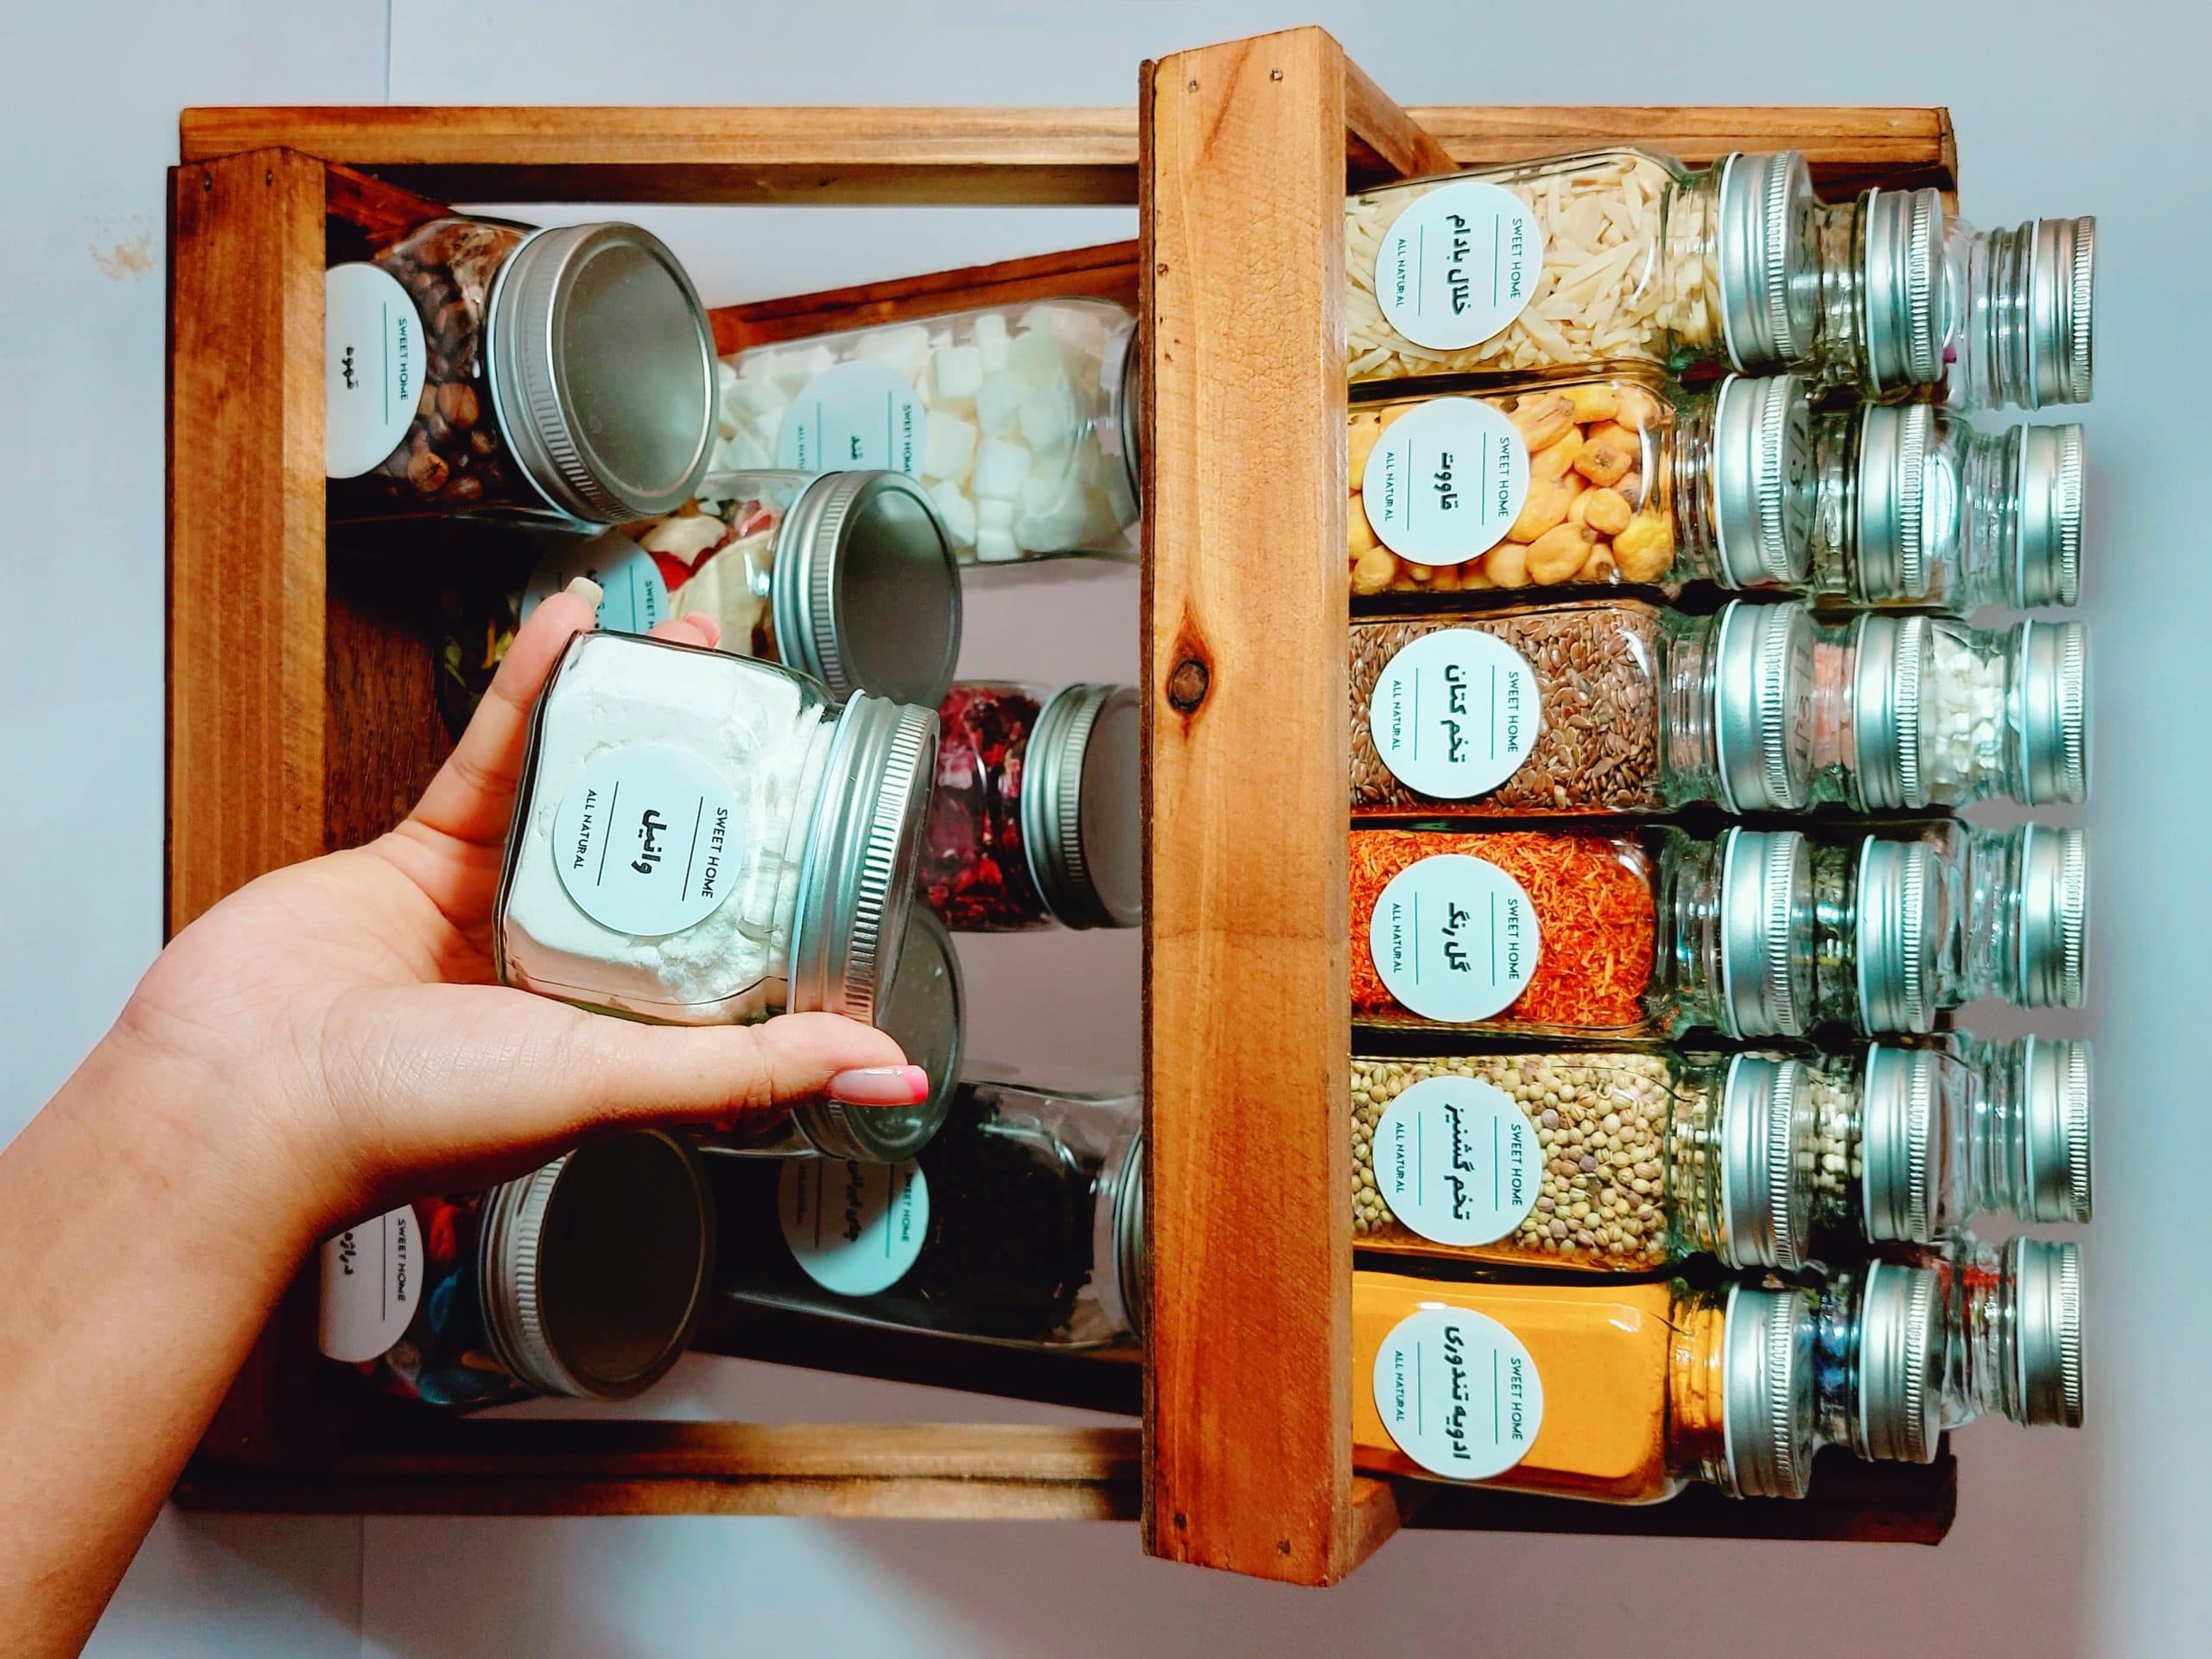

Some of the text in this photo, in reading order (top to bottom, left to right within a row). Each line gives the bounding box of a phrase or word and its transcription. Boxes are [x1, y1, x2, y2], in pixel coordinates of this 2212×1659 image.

[1395, 238, 1407, 308] ALL NATURAL
[1446, 214, 1471, 315] خلال بادام
[1509, 218, 1523, 300] SWEET HOME
[342, 346, 359, 390] قهوه
[398, 318, 409, 401] SWEET HOME
[903, 404, 912, 474] SWEET HOME
[1384, 451, 1395, 522] ALL NATURAL
[1434, 452, 1459, 512] قاووت
[1497, 435, 1510, 518] SWEET HOME
[645, 581, 655, 617] SWEET
[1391, 679, 1402, 751] ALL NATURAL
[1441, 664, 1468, 763] تخم کتان
[1507, 671, 1519, 753] SWEET HOME
[573, 789, 598, 869] ALL NATURAL
[631, 810, 667, 875] وانیل
[702, 807, 728, 899] SWEET HOME
[1392, 903, 1402, 975] ALL NATURAL
[1446, 941, 1471, 973] گل
[1507, 898, 1520, 981] SWEET HOME
[1395, 1122, 1406, 1194] ALL NATURAL
[1444, 1103, 1476, 1220] تخم گشنیز
[1510, 1123, 1522, 1206] SWEET HOME
[397, 1218, 406, 1260] SWEET
[901, 1173, 913, 1243] SWEET HOME
[1395, 1350, 1405, 1422] ALL NATURAL
[1442, 1325, 1471, 1460] ادویه تندوری
[1510, 1356, 1523, 1440] SWEET HOME
